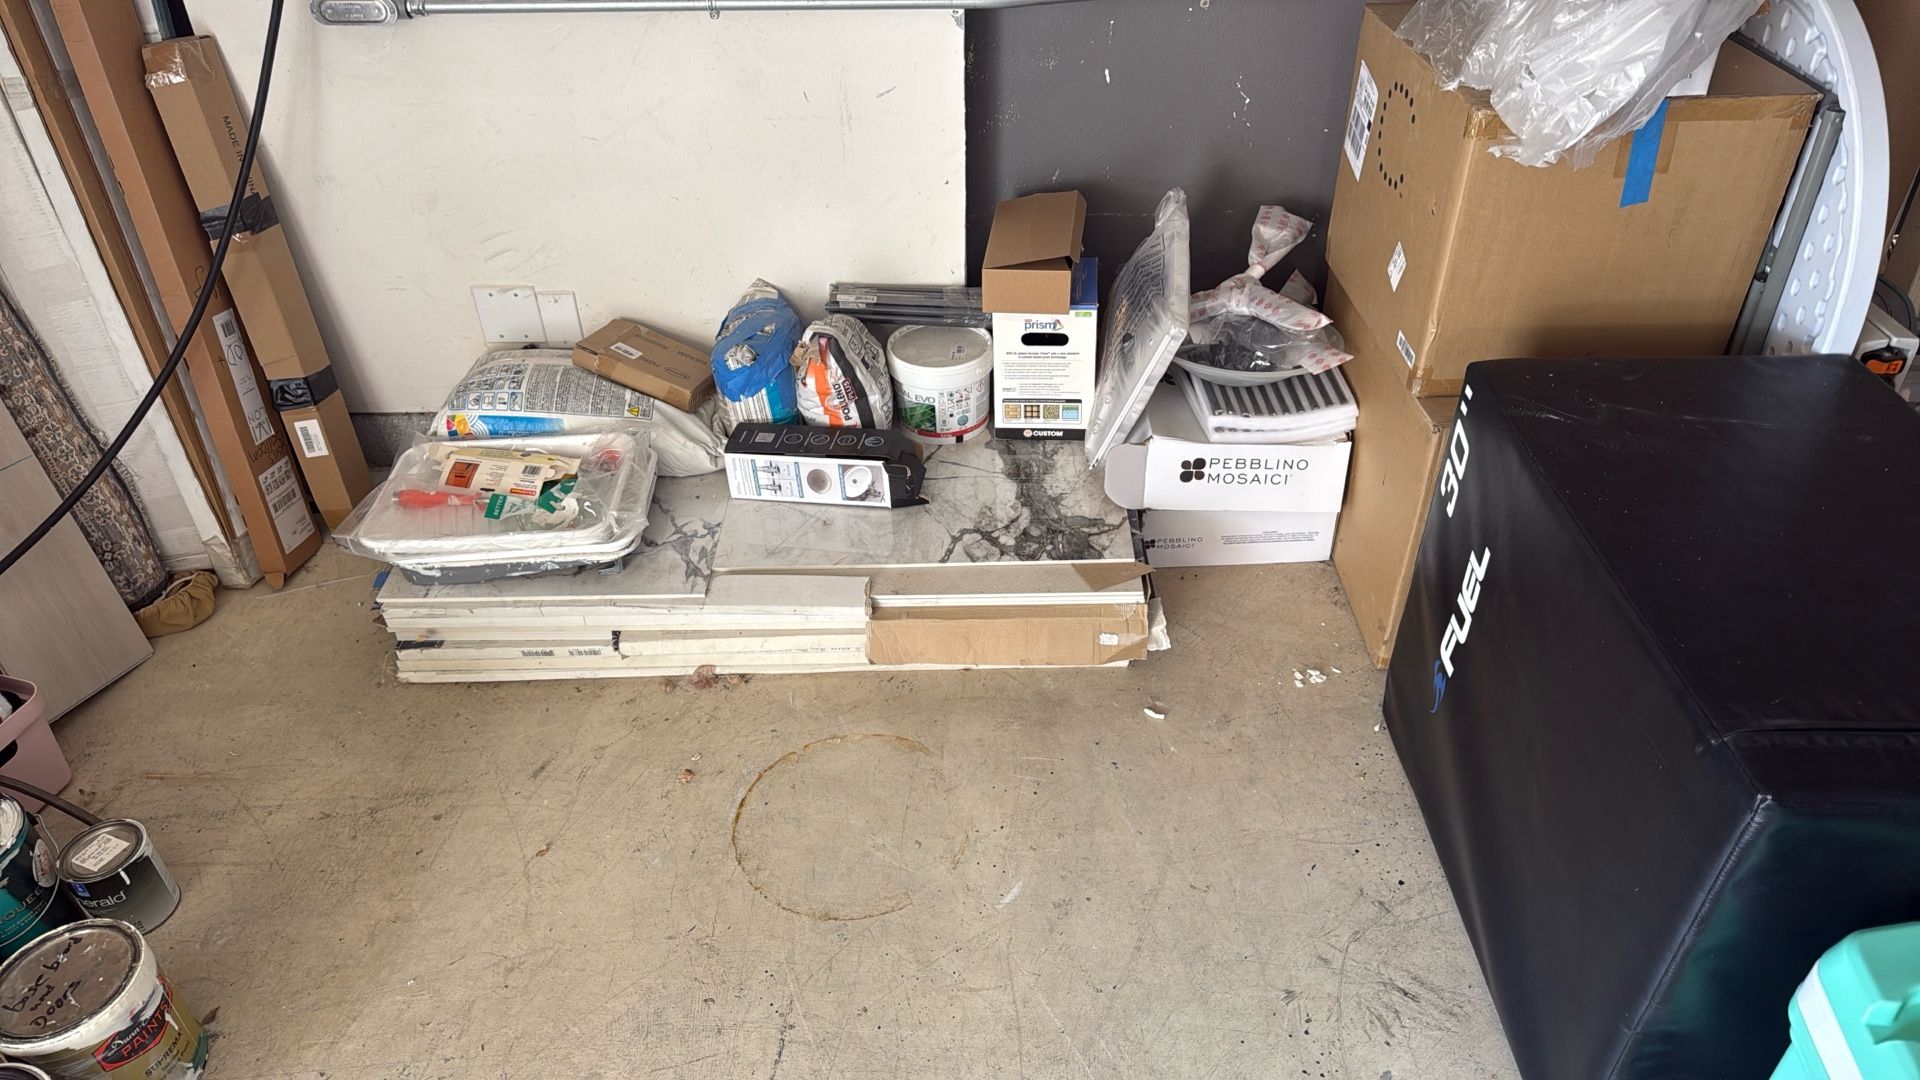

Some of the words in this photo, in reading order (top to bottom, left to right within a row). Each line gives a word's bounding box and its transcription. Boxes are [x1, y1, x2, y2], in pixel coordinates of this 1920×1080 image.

[222, 114, 241, 149] MADE
[1024, 319, 1058, 331] prism
[914, 394, 936, 404] EVO
[1208, 457, 1309, 471] PEBBLINO
[1156, 536, 1204, 544] PEBBLINO
[1440, 546, 1491, 678] FUEL
[0, 886, 44, 922] QUEE
[82, 890, 127, 908] erald
[120, 1002, 171, 1058] PAINTS
[144, 1032, 183, 1078] SUPREMA
